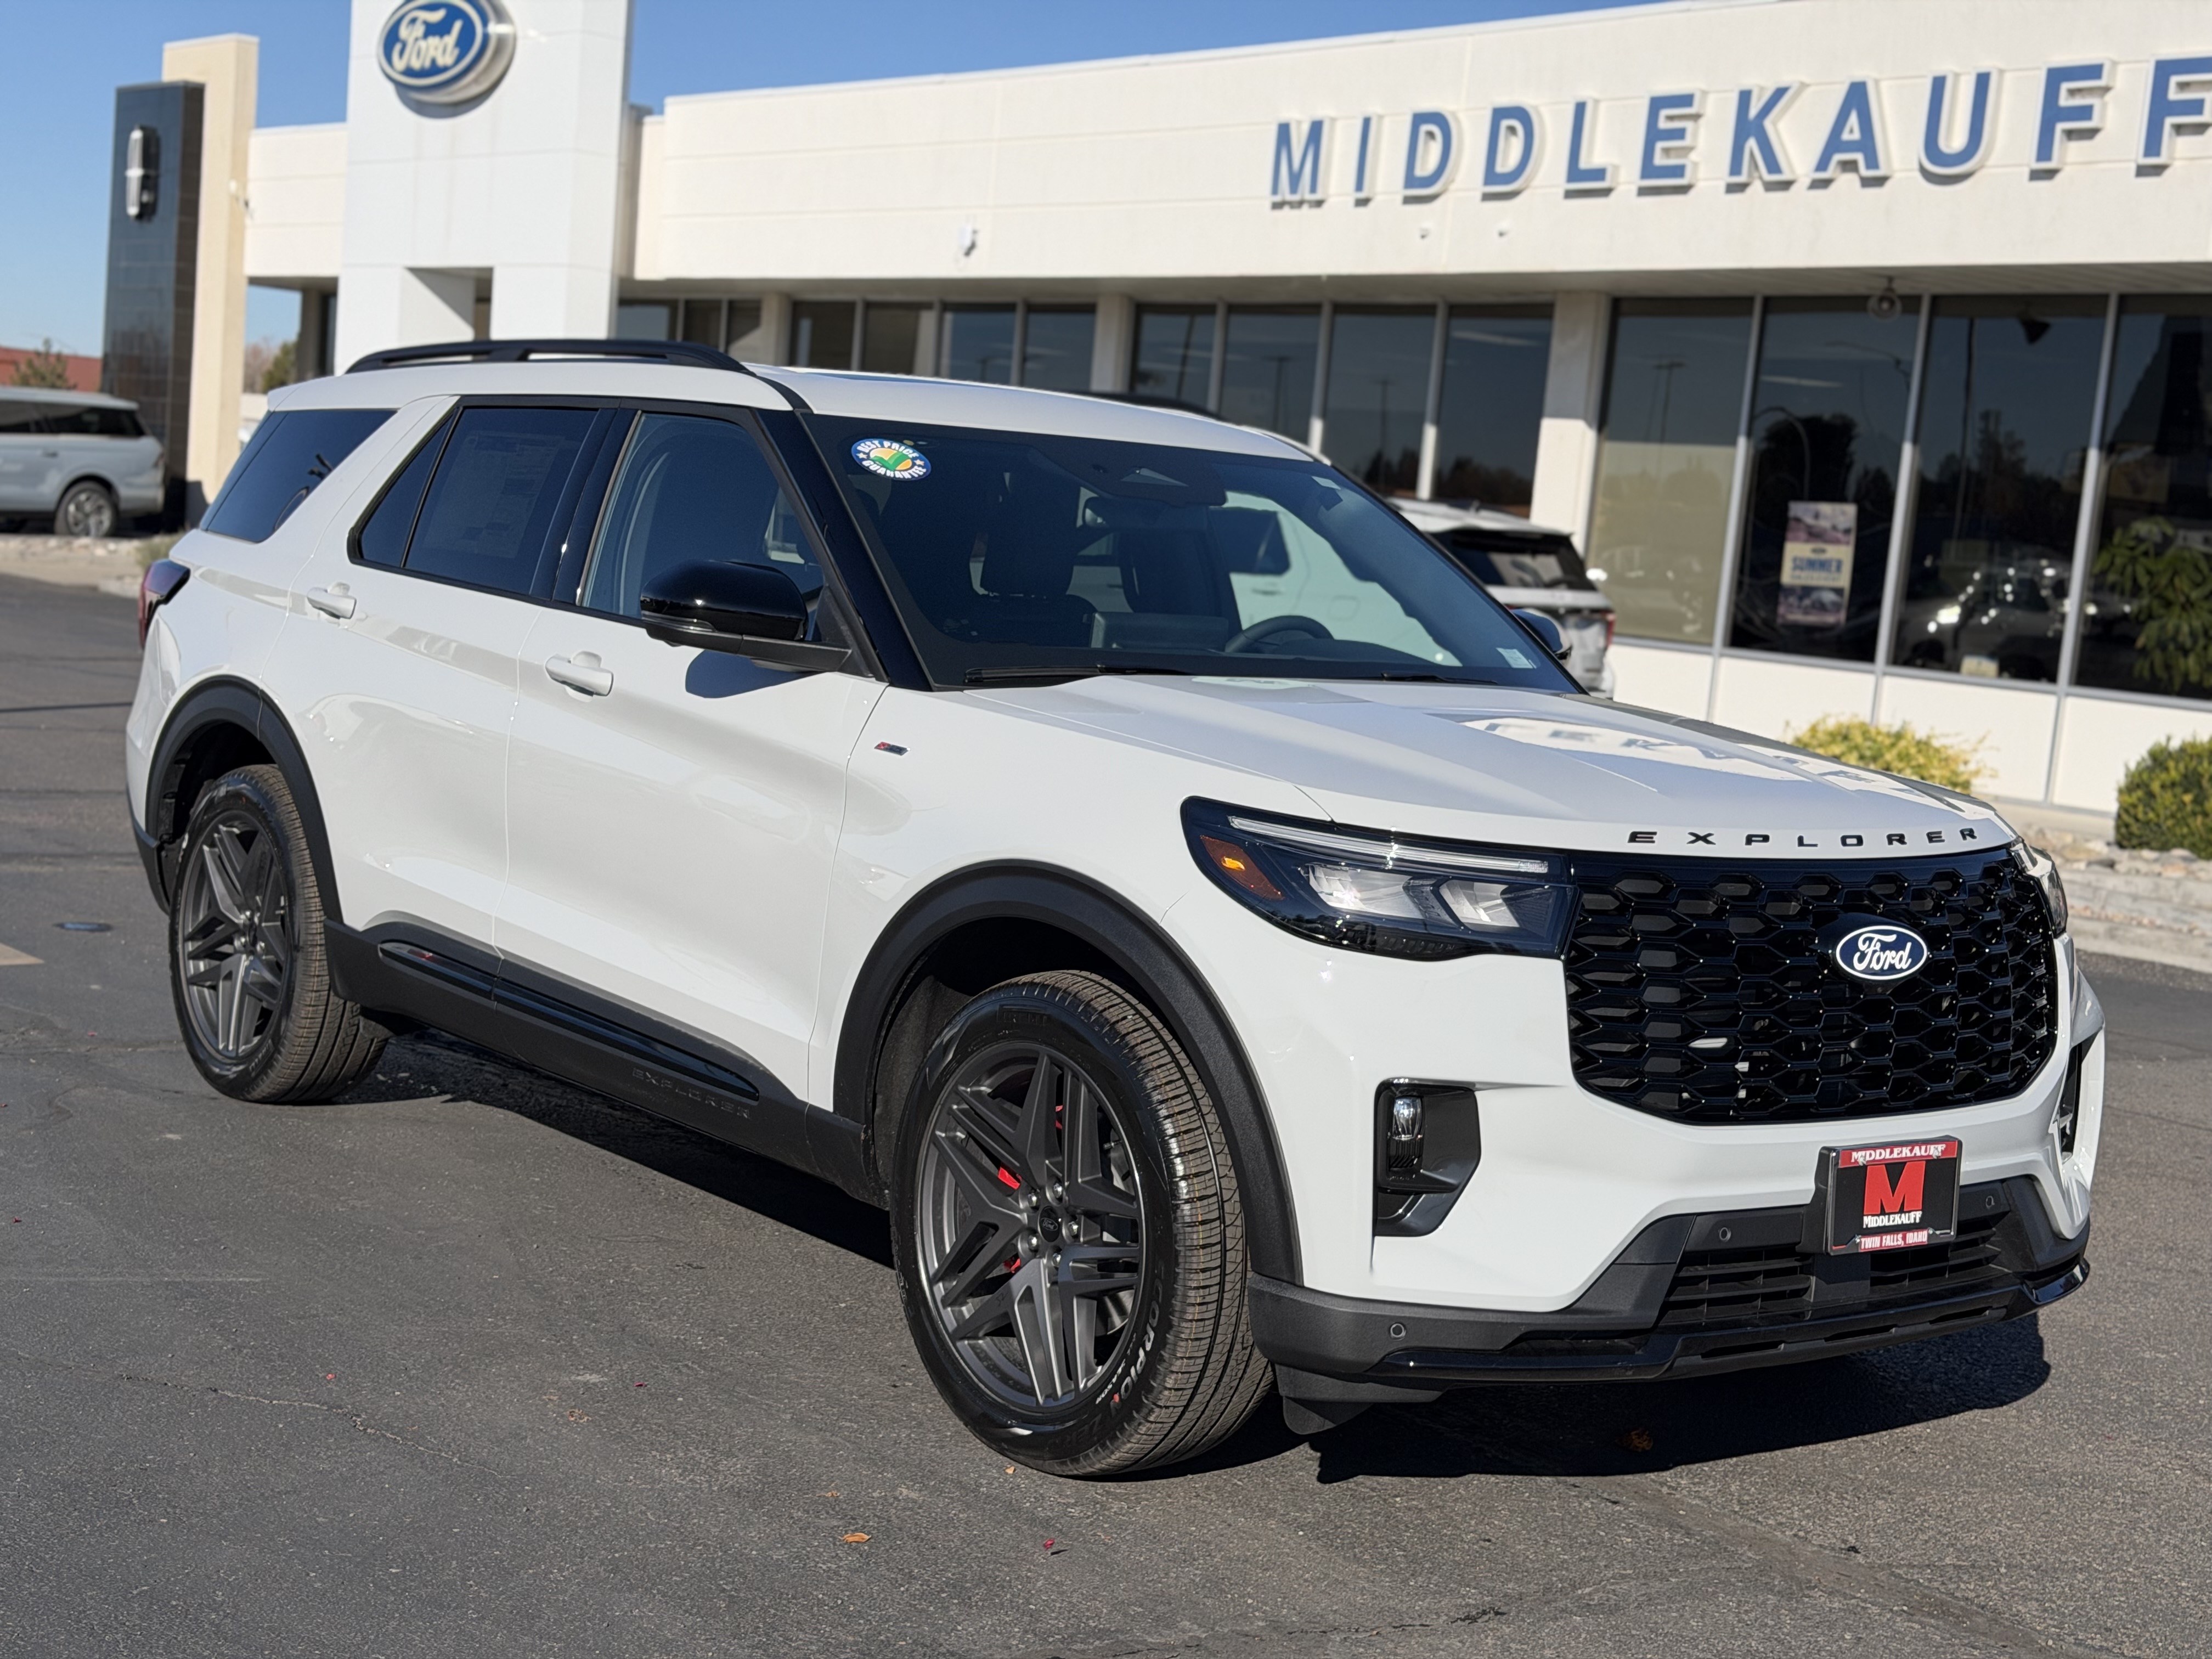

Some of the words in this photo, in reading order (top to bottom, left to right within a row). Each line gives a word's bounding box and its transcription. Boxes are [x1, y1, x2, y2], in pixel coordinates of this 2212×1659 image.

[392, 8, 464, 72] Ford
[1271, 56, 2212, 206] MIDDLEKAUFF
[883, 441, 919, 459] PRICE
[861, 460, 927, 478] GUARANTEE
[1627, 827, 1977, 848] EXPLORER
[1853, 933, 1912, 970] Ford
[1863, 1160, 1926, 1215] M
[1863, 1211, 1922, 1228] MIDDLEKAUFF
[1861, 1235, 1880, 1249] TWIN
[1882, 1233, 1904, 1247] FALLS,
[1906, 1231, 1927, 1244] IDAHO
